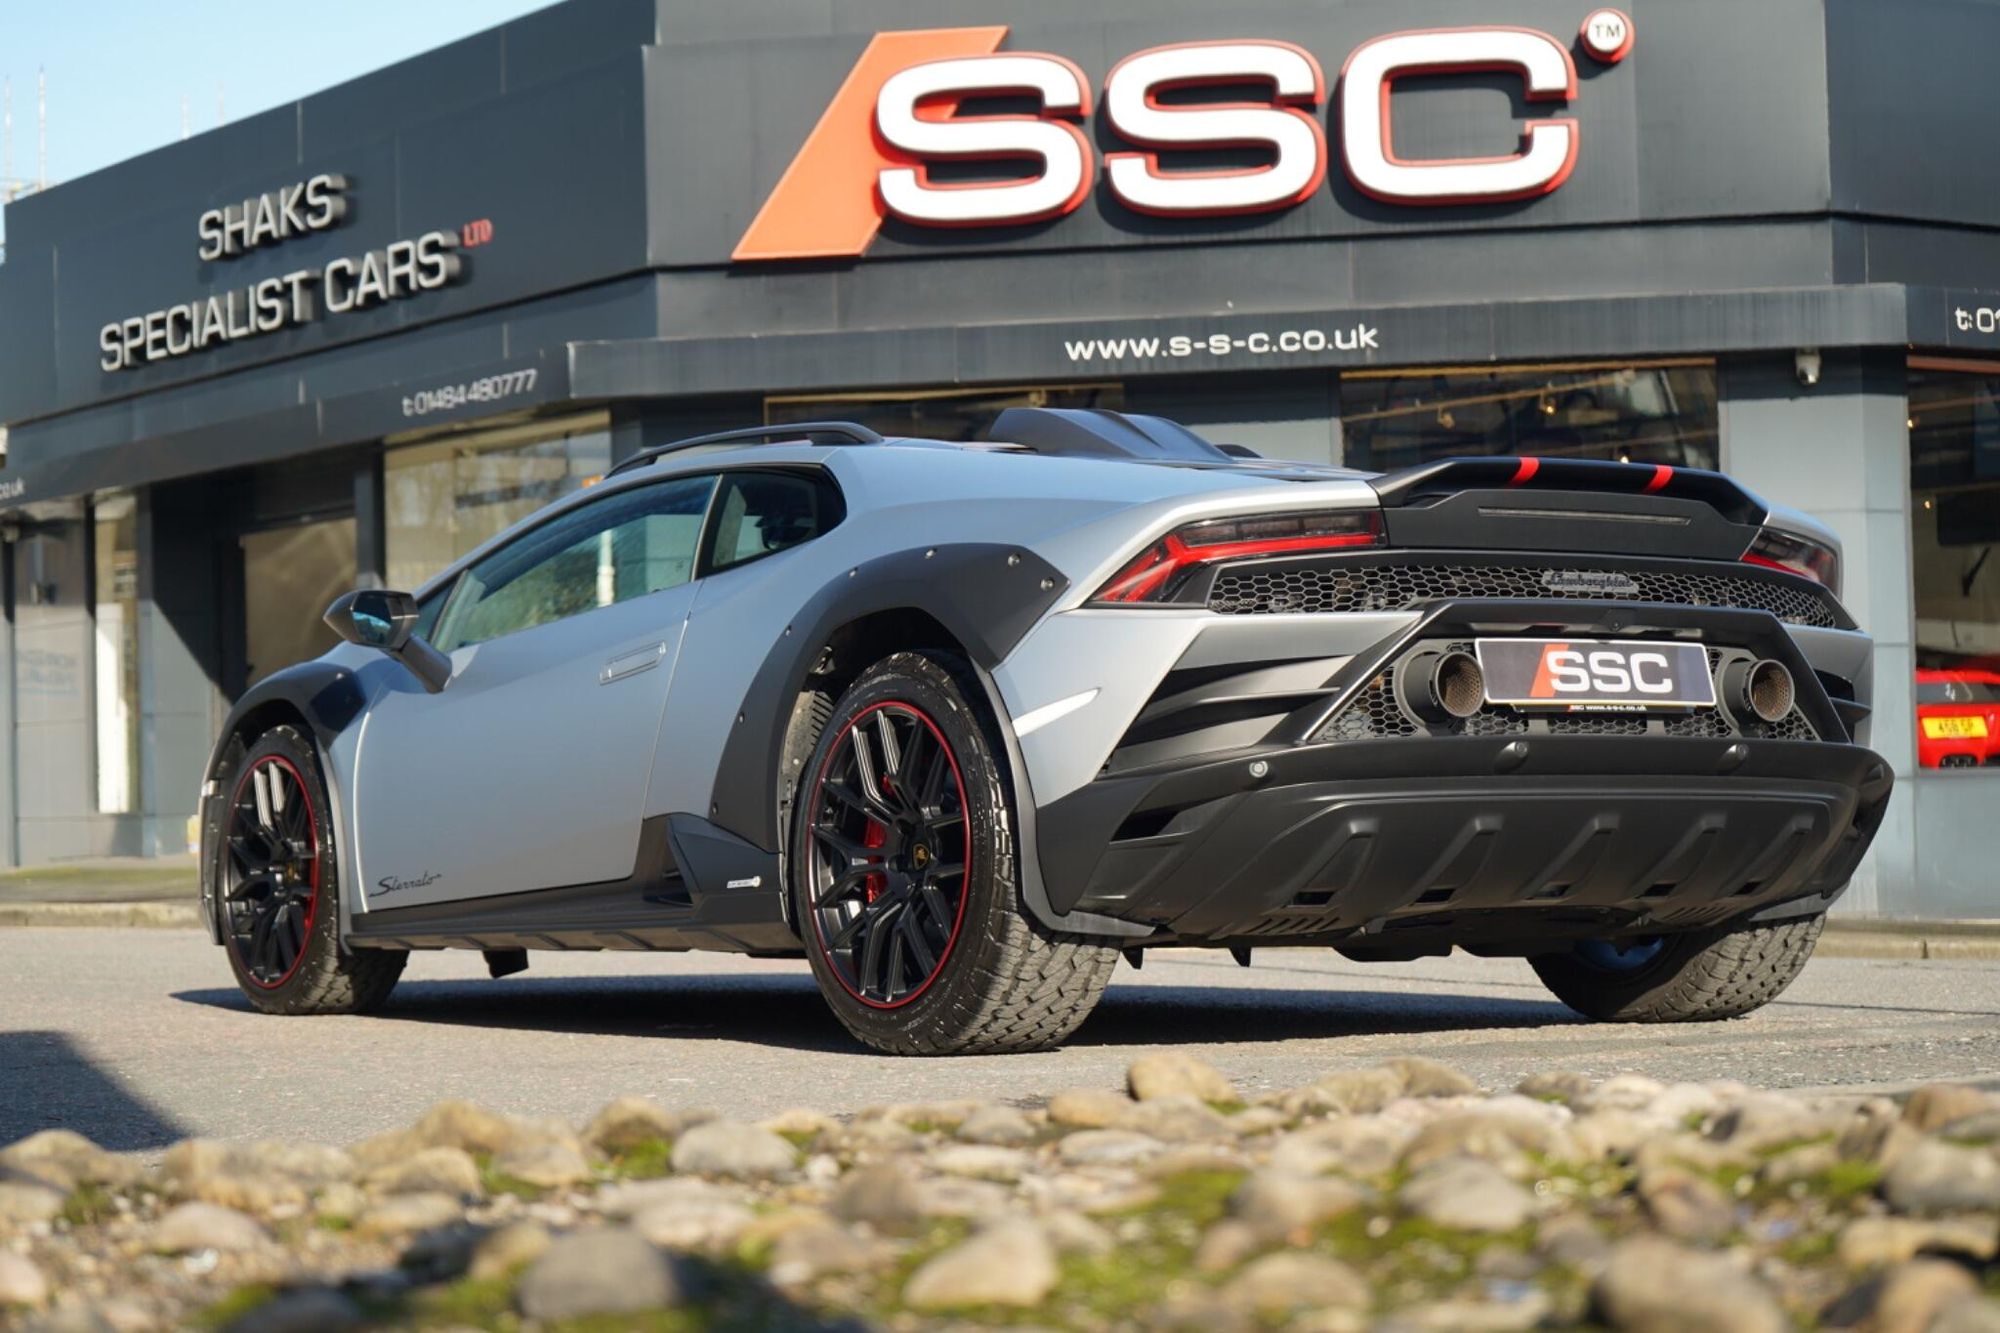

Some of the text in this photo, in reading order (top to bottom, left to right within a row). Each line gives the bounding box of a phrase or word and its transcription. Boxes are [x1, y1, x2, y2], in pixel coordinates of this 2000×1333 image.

[874, 24, 1620, 227] SSC TM
[199, 173, 346, 261] SHAKS
[100, 218, 493, 371] SPECIALIST CARS LTD
[1064, 323, 1379, 361] www.s-s-c.co.uk
[1546, 650, 1674, 694] SSC
